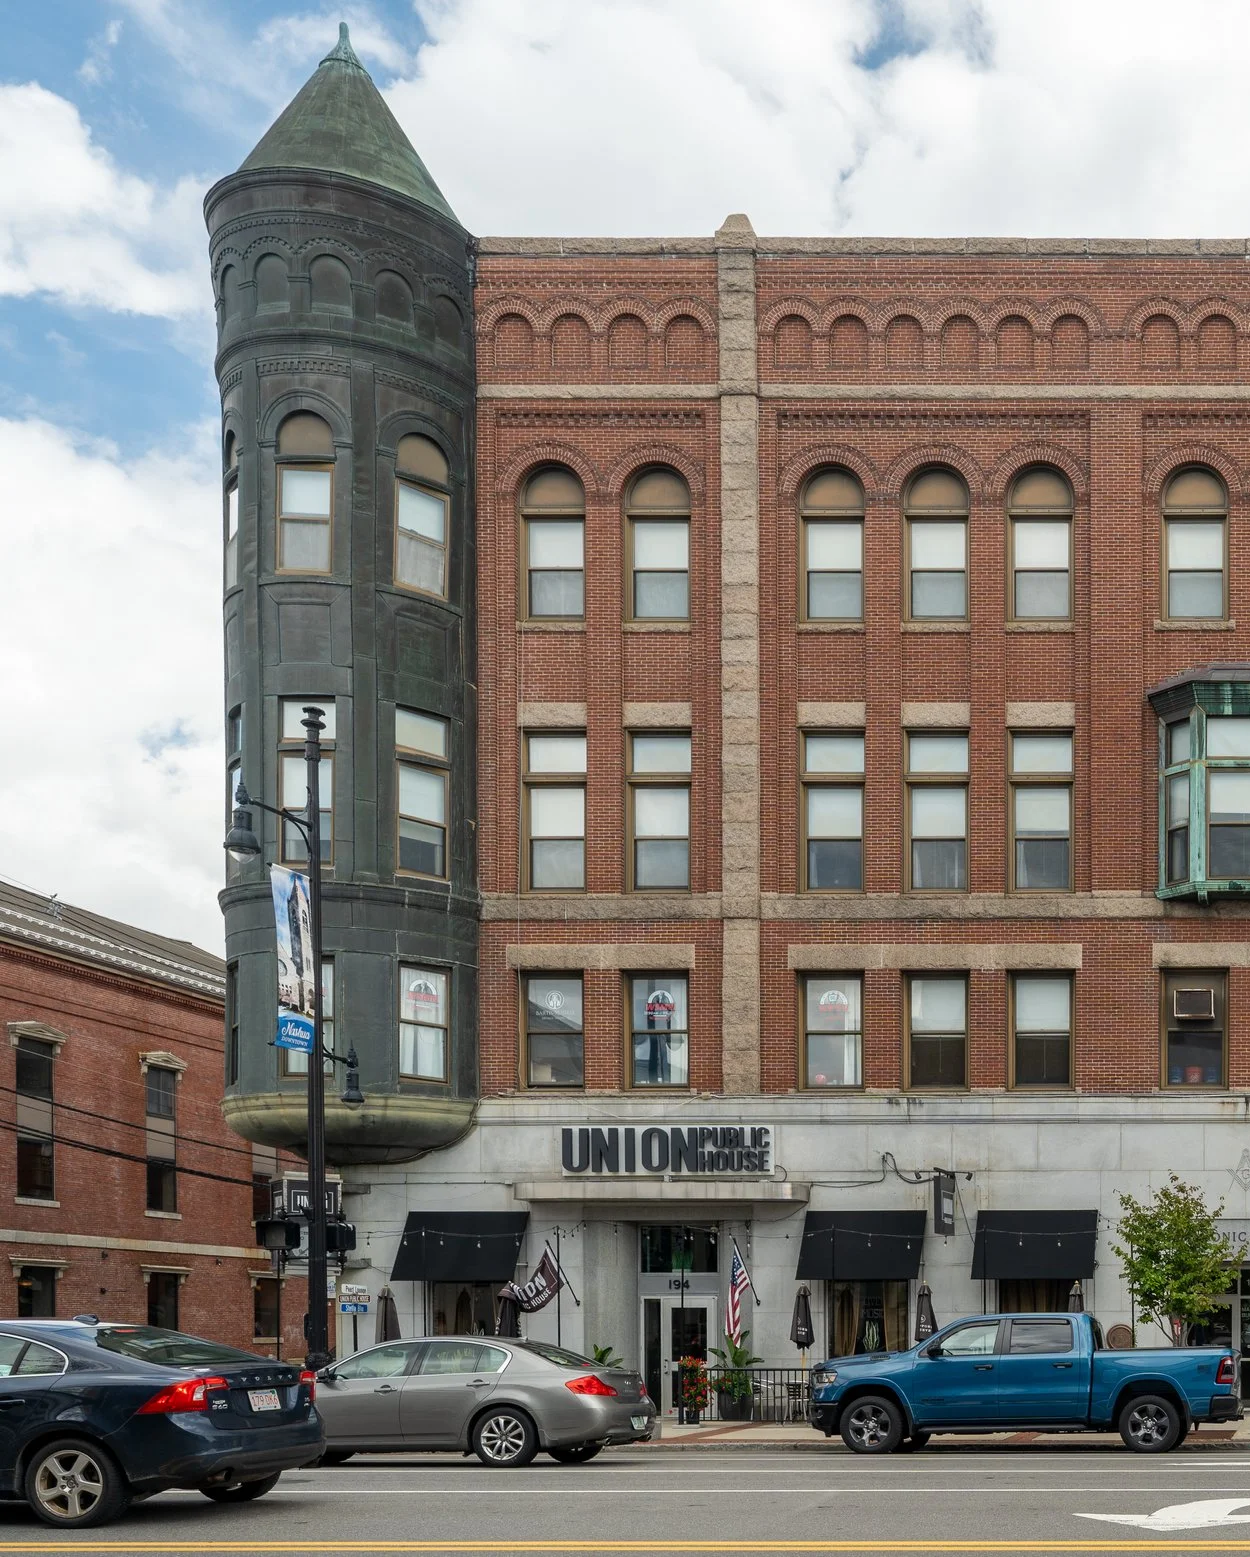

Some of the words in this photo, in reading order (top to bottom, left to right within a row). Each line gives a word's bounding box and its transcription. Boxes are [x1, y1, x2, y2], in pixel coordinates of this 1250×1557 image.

[281, 1021, 311, 1040] Nashua
[280, 1036, 308, 1047] DOWNTOWN
[562, 1127, 698, 1173] UNION
[699, 1126, 770, 1149] PUBLIC
[699, 1150, 770, 1173] HOUSE
[1213, 1231, 1247, 1242] ONIC
[668, 1279, 690, 1290] 194
[530, 1287, 552, 1307] HOUSE
[241, 1374, 293, 1382] VOLVO
